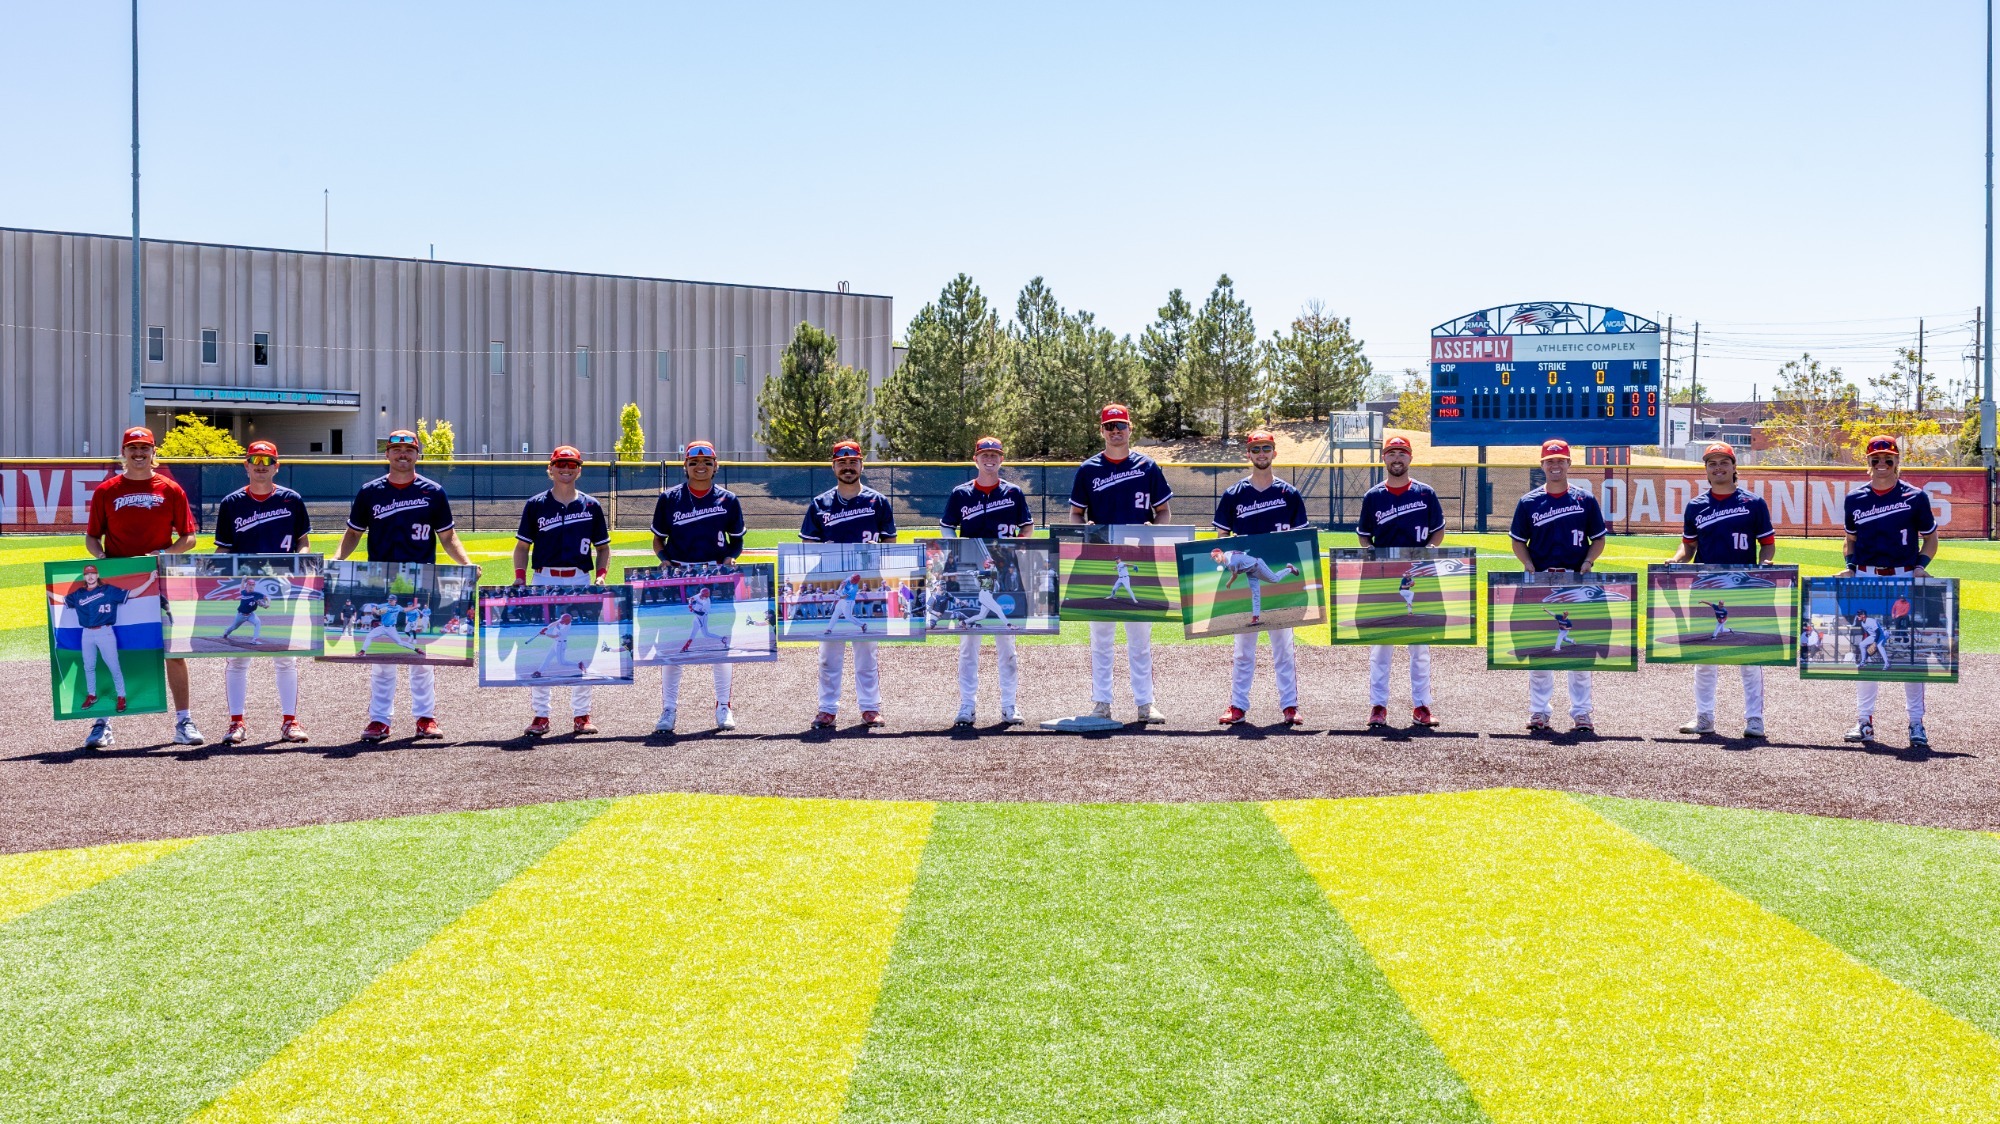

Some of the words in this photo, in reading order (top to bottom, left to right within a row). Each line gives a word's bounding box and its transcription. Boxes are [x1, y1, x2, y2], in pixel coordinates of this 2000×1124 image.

[1465, 321, 1489, 330] RMAC
[1605, 320, 1625, 328] NCAA
[1435, 340, 1508, 359] ASSEMBLY
[1536, 344, 1584, 352] ATHLETIC
[1586, 342, 1636, 352] COMPLEX
[1440, 364, 1456, 372] SOP
[1495, 363, 1516, 372] BALL
[1538, 362, 1566, 371] STRIKE
[1592, 361, 1609, 370] OUT
[1633, 361, 1648, 370] H/E
[1502, 372, 1510, 385] 0
[1548, 371, 1557, 385] 0
[1596, 370, 1605, 384] 0
[219, 390, 287, 400] MAINTENANCE
[292, 392, 302, 400] OF
[305, 393, 323, 402] WAY
[1597, 385, 1615, 393] RUNS
[1441, 396, 1456, 405] CMU
[1607, 393, 1614, 404] 0
[1632, 392, 1639, 404] 0
[1648, 392, 1655, 404] 0
[1440, 408, 1459, 417] MSUD
[1607, 405, 1614, 417] 0
[1632, 405, 1639, 416] 0
[1648, 405, 1655, 416] 0
[1092, 468, 1145, 491] Roadrunners
[113, 494, 165, 511] ROADRUNNERS
[373, 498, 428, 519] Roadrunners
[961, 497, 1015, 520] Roadrunners
[1134, 491, 1151, 509] 21
[1236, 498, 1287, 518] Roadrunners
[234, 507, 291, 532] Roadrunners
[673, 505, 727, 525] Roadrunners
[822, 506, 876, 526] Roadrunners
[1375, 500, 1428, 524] Roadrunners
[1531, 504, 1584, 526] Roadrunners
[1695, 506, 1750, 529] Roadrunners
[1853, 501, 1911, 524] Roadrunners
[538, 511, 593, 531] Roadrunners
[411, 523, 431, 540] 30
[717, 530, 725, 547] 9
[1900, 528, 1908, 545] 1
[280, 534, 293, 552] 4
[580, 538, 591, 555] 6
[98, 603, 112, 613] 43
